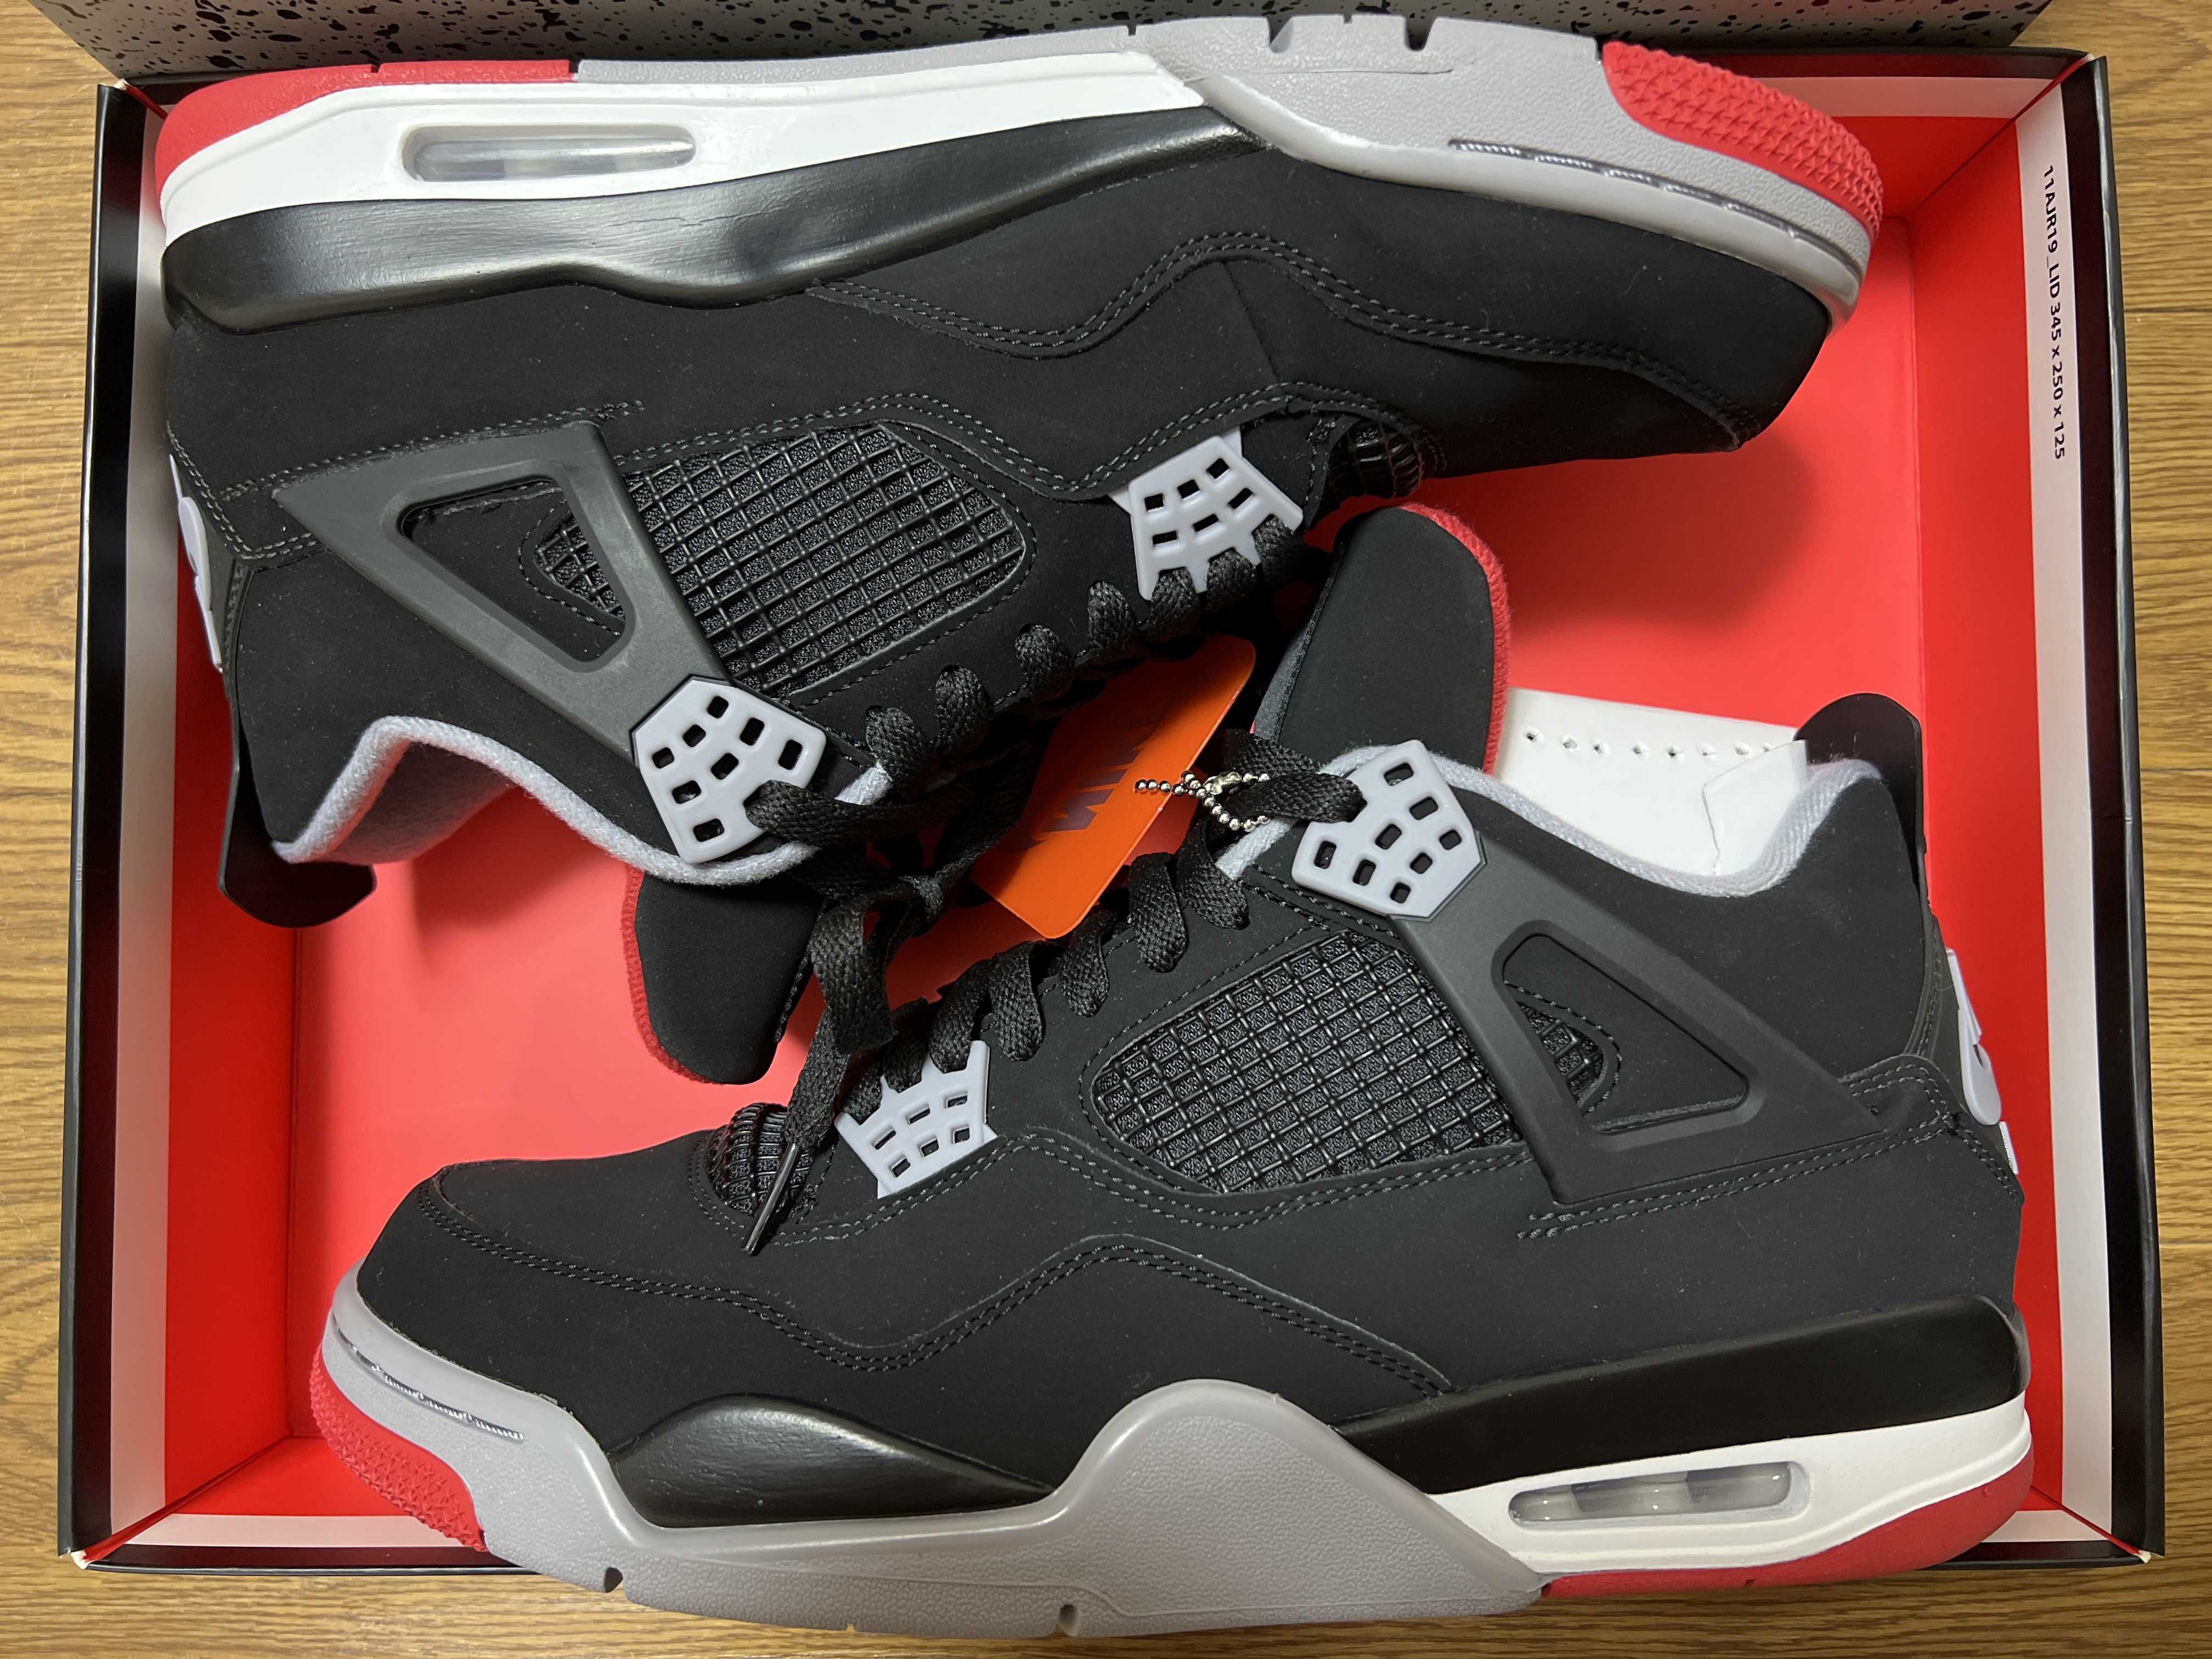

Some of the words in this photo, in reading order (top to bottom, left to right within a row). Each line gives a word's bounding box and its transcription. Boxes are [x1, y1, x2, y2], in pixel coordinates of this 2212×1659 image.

[2050, 302, 2062, 341] 345
[2052, 345, 2059, 360] x
[2052, 361, 2063, 400] 250
[2053, 404, 2062, 419] x
[2054, 421, 2065, 460] 125
